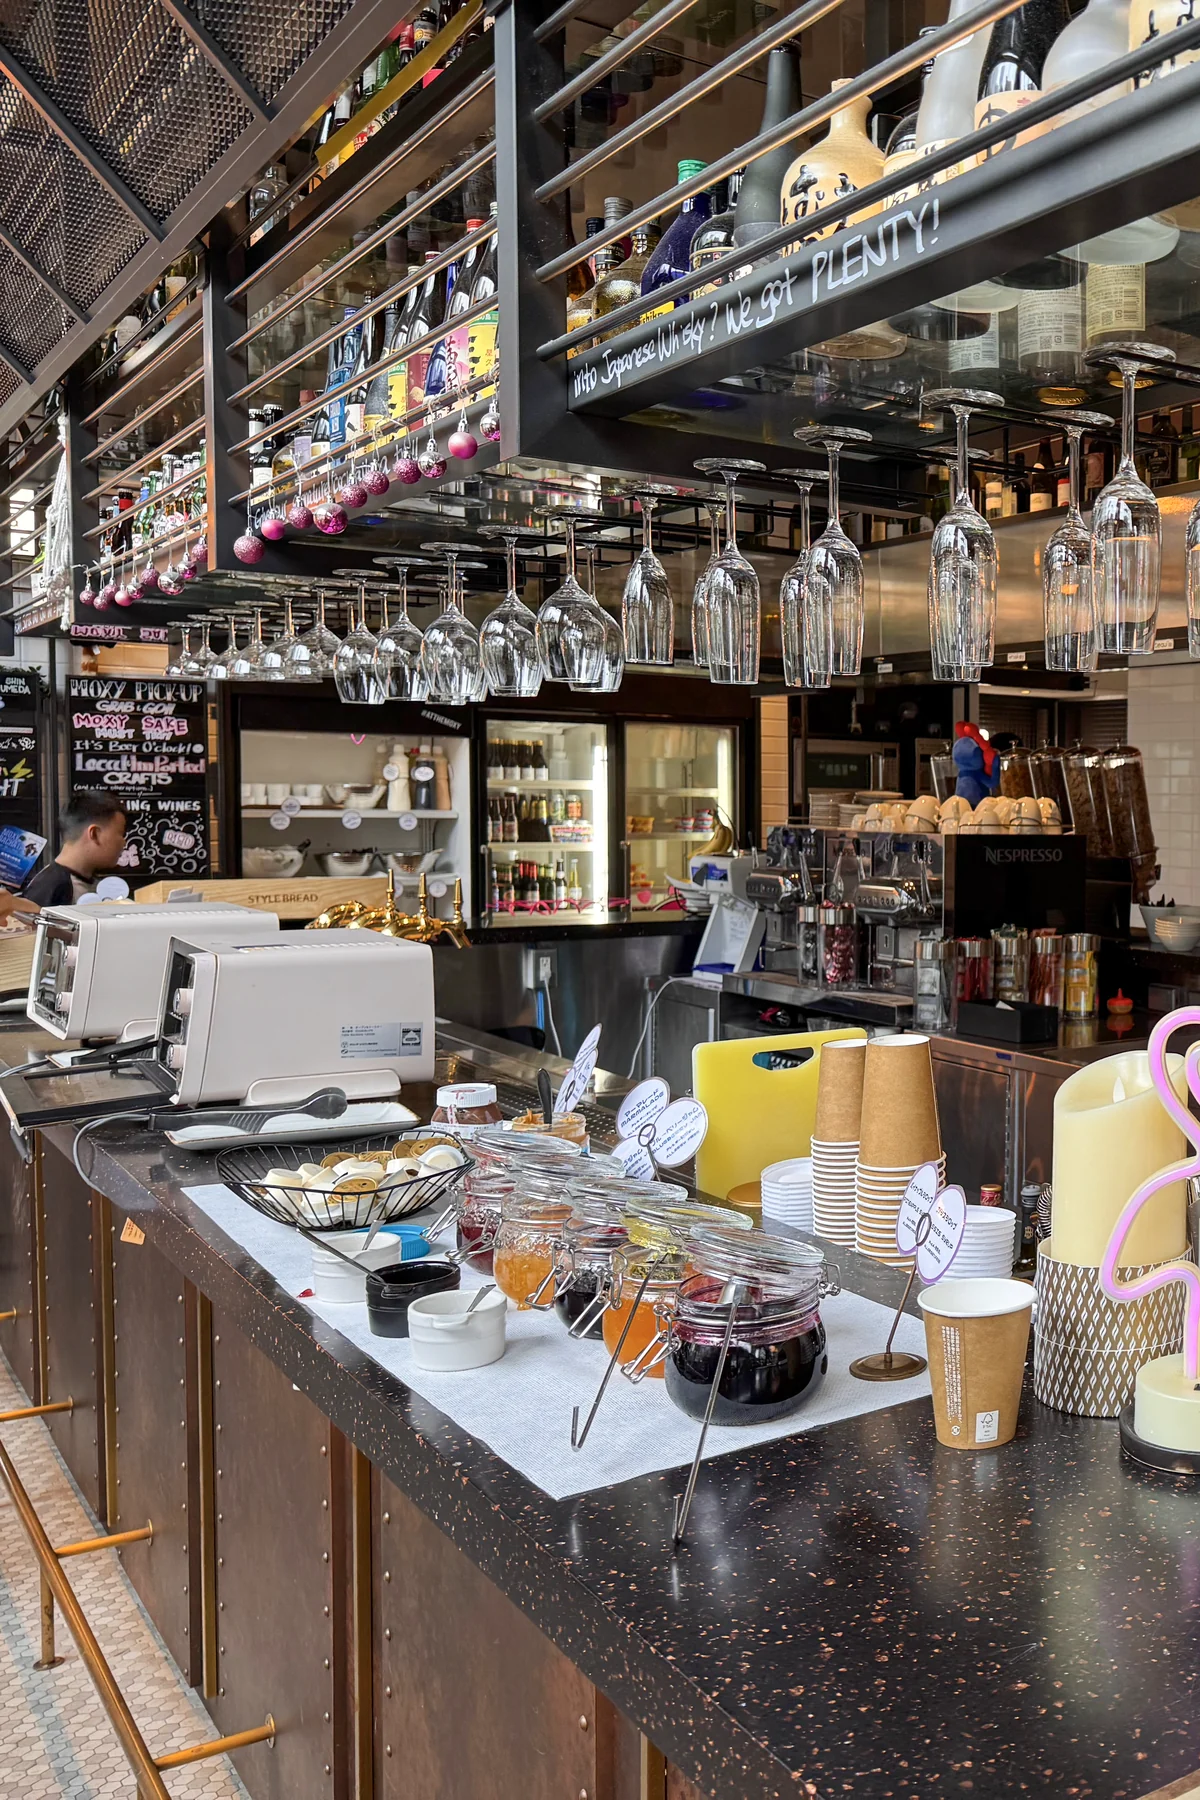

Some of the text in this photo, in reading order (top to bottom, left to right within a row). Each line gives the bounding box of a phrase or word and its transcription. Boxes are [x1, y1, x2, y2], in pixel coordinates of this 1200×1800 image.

[574, 198, 941, 398] into Japanese Whisky? We got PLENTY!
[5, 677, 25, 686] SHIN
[70, 679, 203, 703] MOXY PICK-UP
[96, 700, 135, 713] GRAB
[73, 713, 188, 735] MOXY SAKE
[421, 709, 462, 730] #ATTHEMOXY
[73, 740, 103, 751] It's
[109, 741, 139, 752] Beer
[103, 772, 172, 785] CRAFTS
[158, 800, 201, 812] WINES
[984, 846, 1064, 864] NESPRESSO
[248, 894, 318, 904] STYLE BREAD
